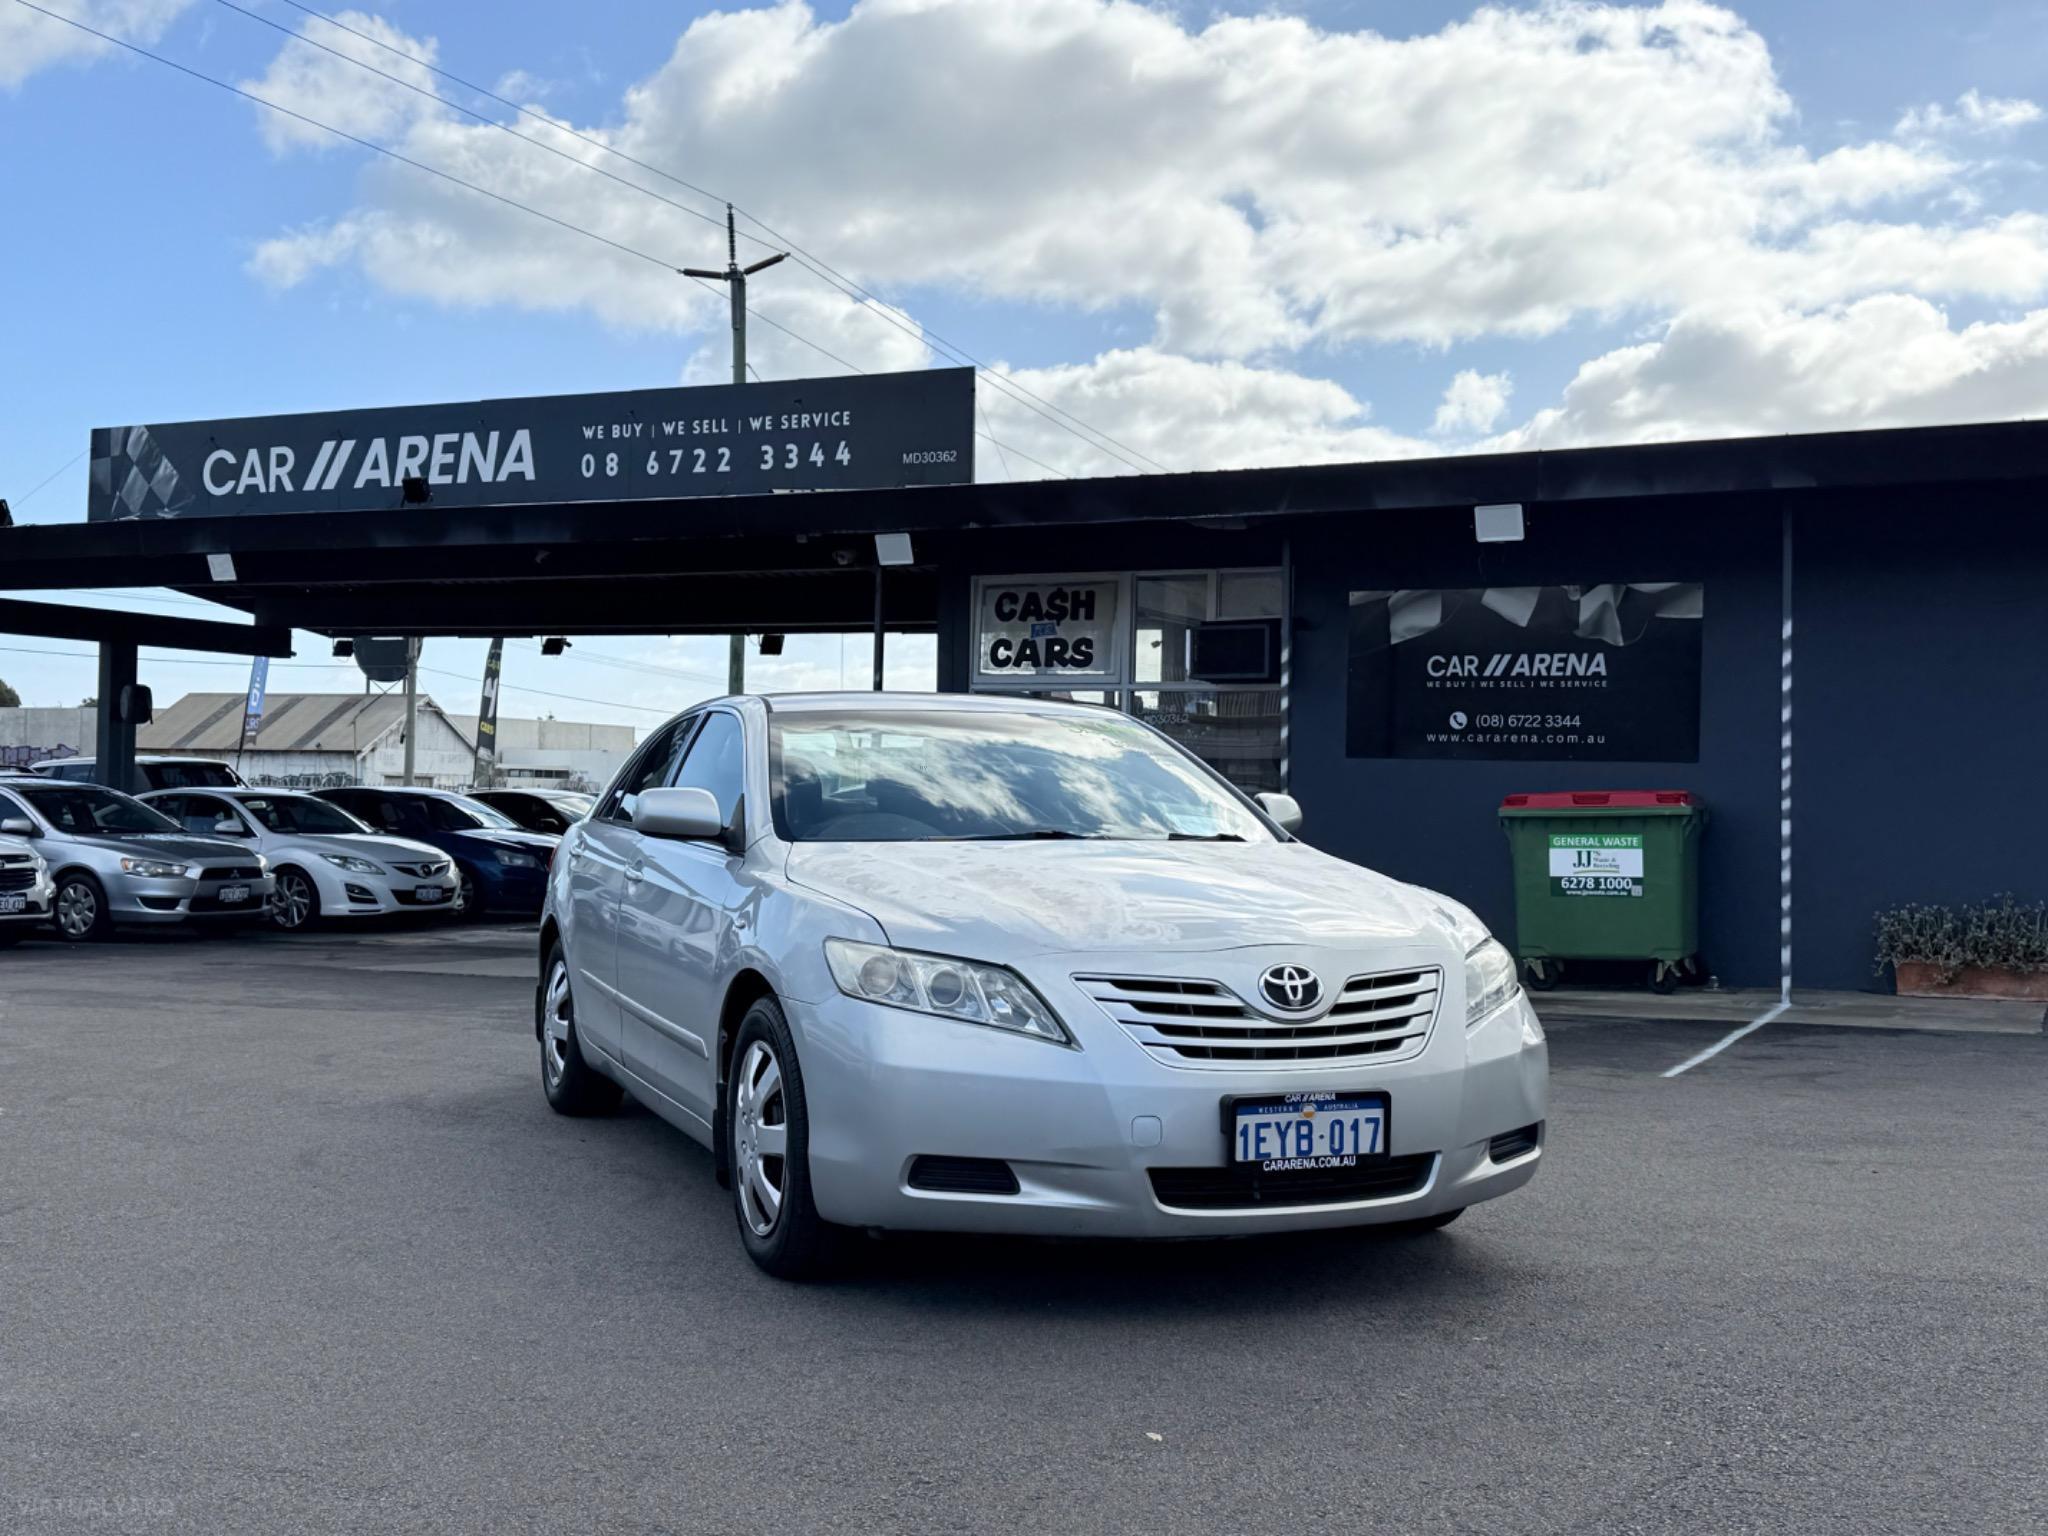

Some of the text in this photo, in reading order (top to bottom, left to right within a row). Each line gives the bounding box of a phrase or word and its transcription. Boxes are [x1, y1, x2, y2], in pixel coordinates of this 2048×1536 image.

[583, 411, 851, 440] WE BUY WE SELL WE SERVICE
[203, 428, 536, 497] CAR ARENA
[581, 441, 851, 478] 08 6722 3344
[902, 450, 958, 465] MD30362
[990, 637, 1094, 668] CARS
[1427, 653, 1607, 677] CAR ARENA
[1476, 714, 1581, 729] (08) 6722 3344
[1426, 733, 1606, 744] www.cararena.com.au
[1553, 837, 1639, 846] GENERAL WASTE
[1561, 877, 1632, 889] 6278 1000
[1285, 1092, 1336, 1104] CAR ARENA
[1259, 1103, 1359, 1114] WESTERN AUSTRALIA
[1263, 1155, 1357, 1172] CARARENA.COM.AU
